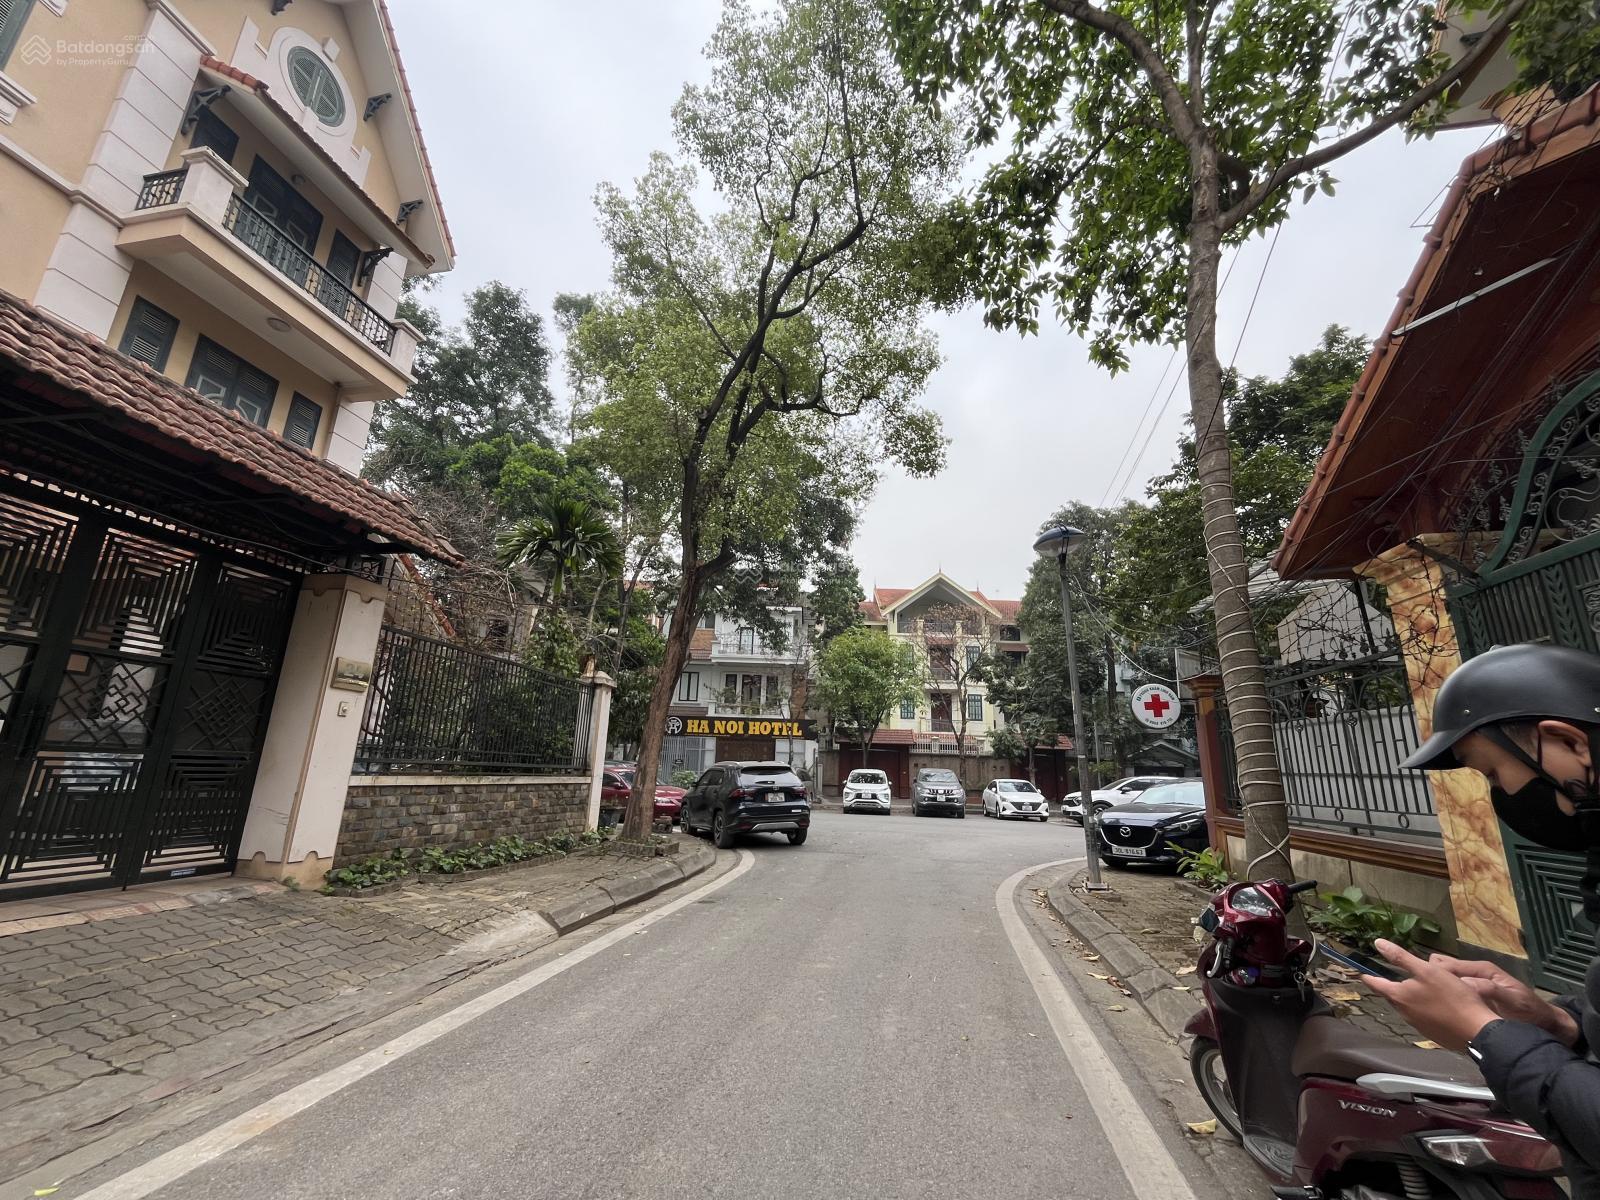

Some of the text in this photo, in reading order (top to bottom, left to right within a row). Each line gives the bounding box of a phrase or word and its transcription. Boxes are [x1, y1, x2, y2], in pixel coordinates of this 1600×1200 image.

[687, 719, 802, 736] HA NOI HOTEL
[1338, 1099, 1398, 1118] VISION
